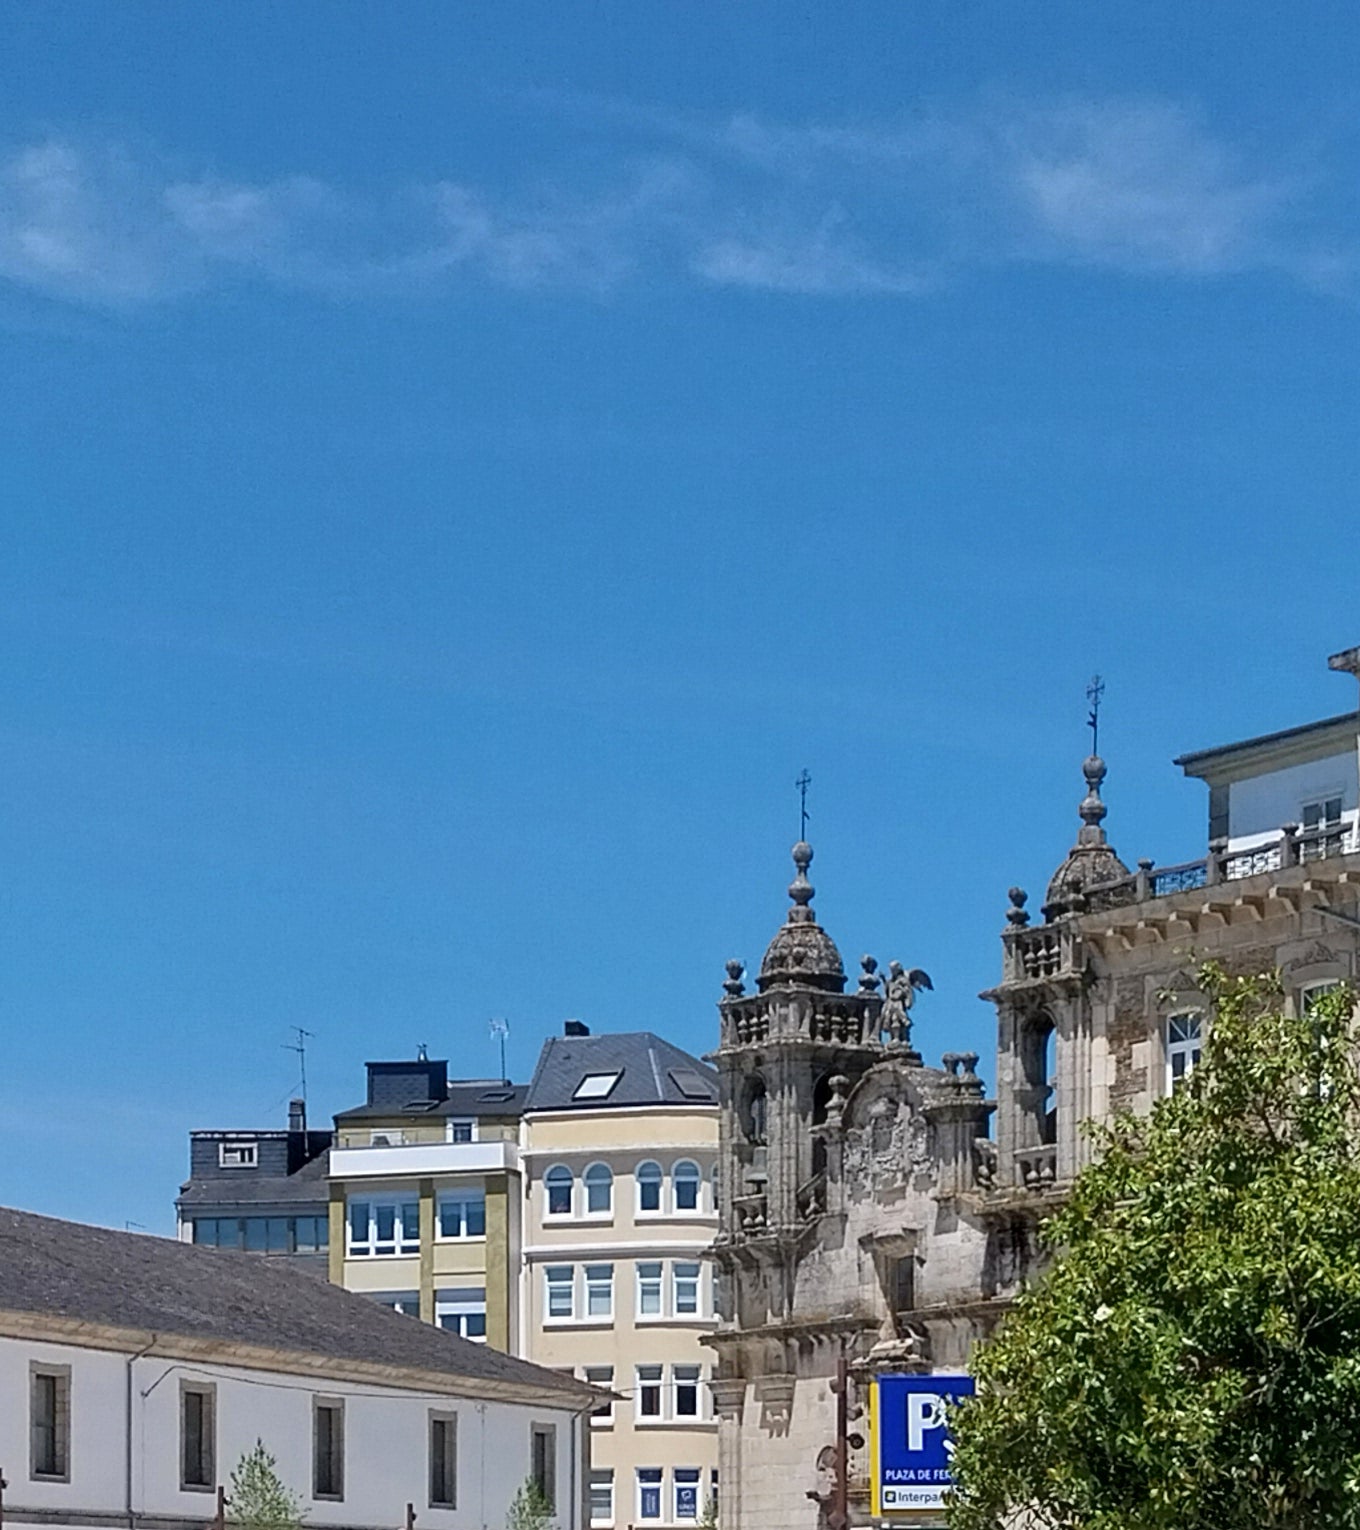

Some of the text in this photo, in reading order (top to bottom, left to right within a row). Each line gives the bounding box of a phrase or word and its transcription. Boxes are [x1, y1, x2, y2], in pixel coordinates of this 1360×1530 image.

[907, 1393, 947, 1451] P
[885, 1469, 916, 1480] PLAZA
[918, 1469, 931, 1480] DE
[898, 1490, 941, 1504] Interpa
